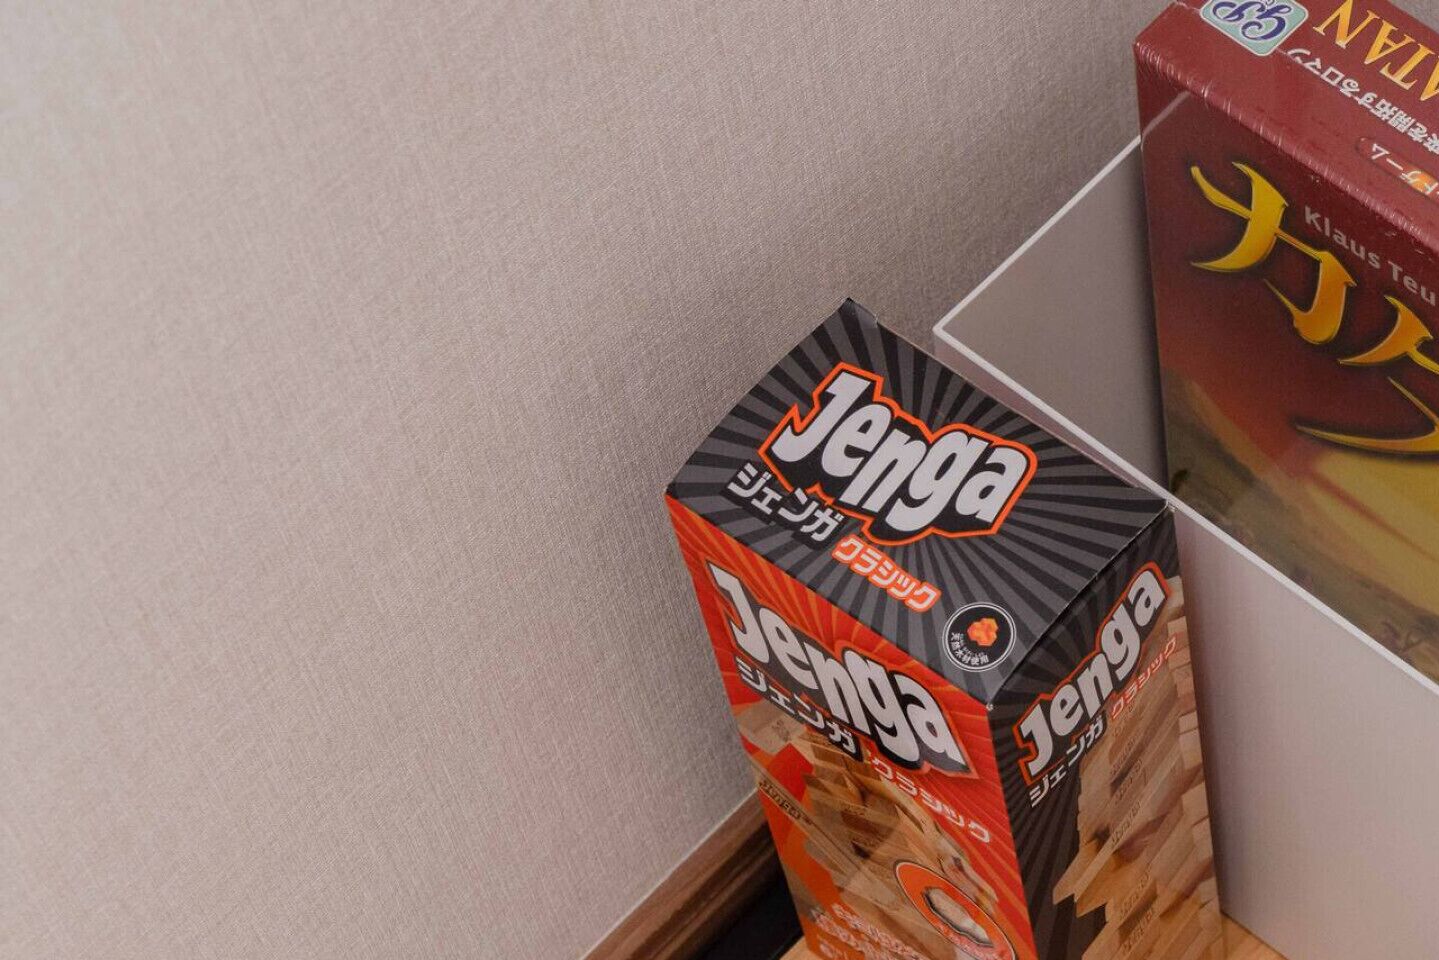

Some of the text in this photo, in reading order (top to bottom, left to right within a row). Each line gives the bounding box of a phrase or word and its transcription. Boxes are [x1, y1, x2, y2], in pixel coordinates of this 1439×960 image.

[1303, 206, 1381, 267] Klaus
[726, 461, 848, 543] ジェンガ
[771, 371, 1025, 533] Jenga
[833, 536, 941, 613] クラシック
[709, 565, 968, 771] Jenga
[735, 658, 992, 843] ジェンガ クラシック
[1020, 567, 1168, 778] Jenga
[1027, 708, 1109, 807] ジェンガ
[1109, 635, 1178, 723] クラシック
